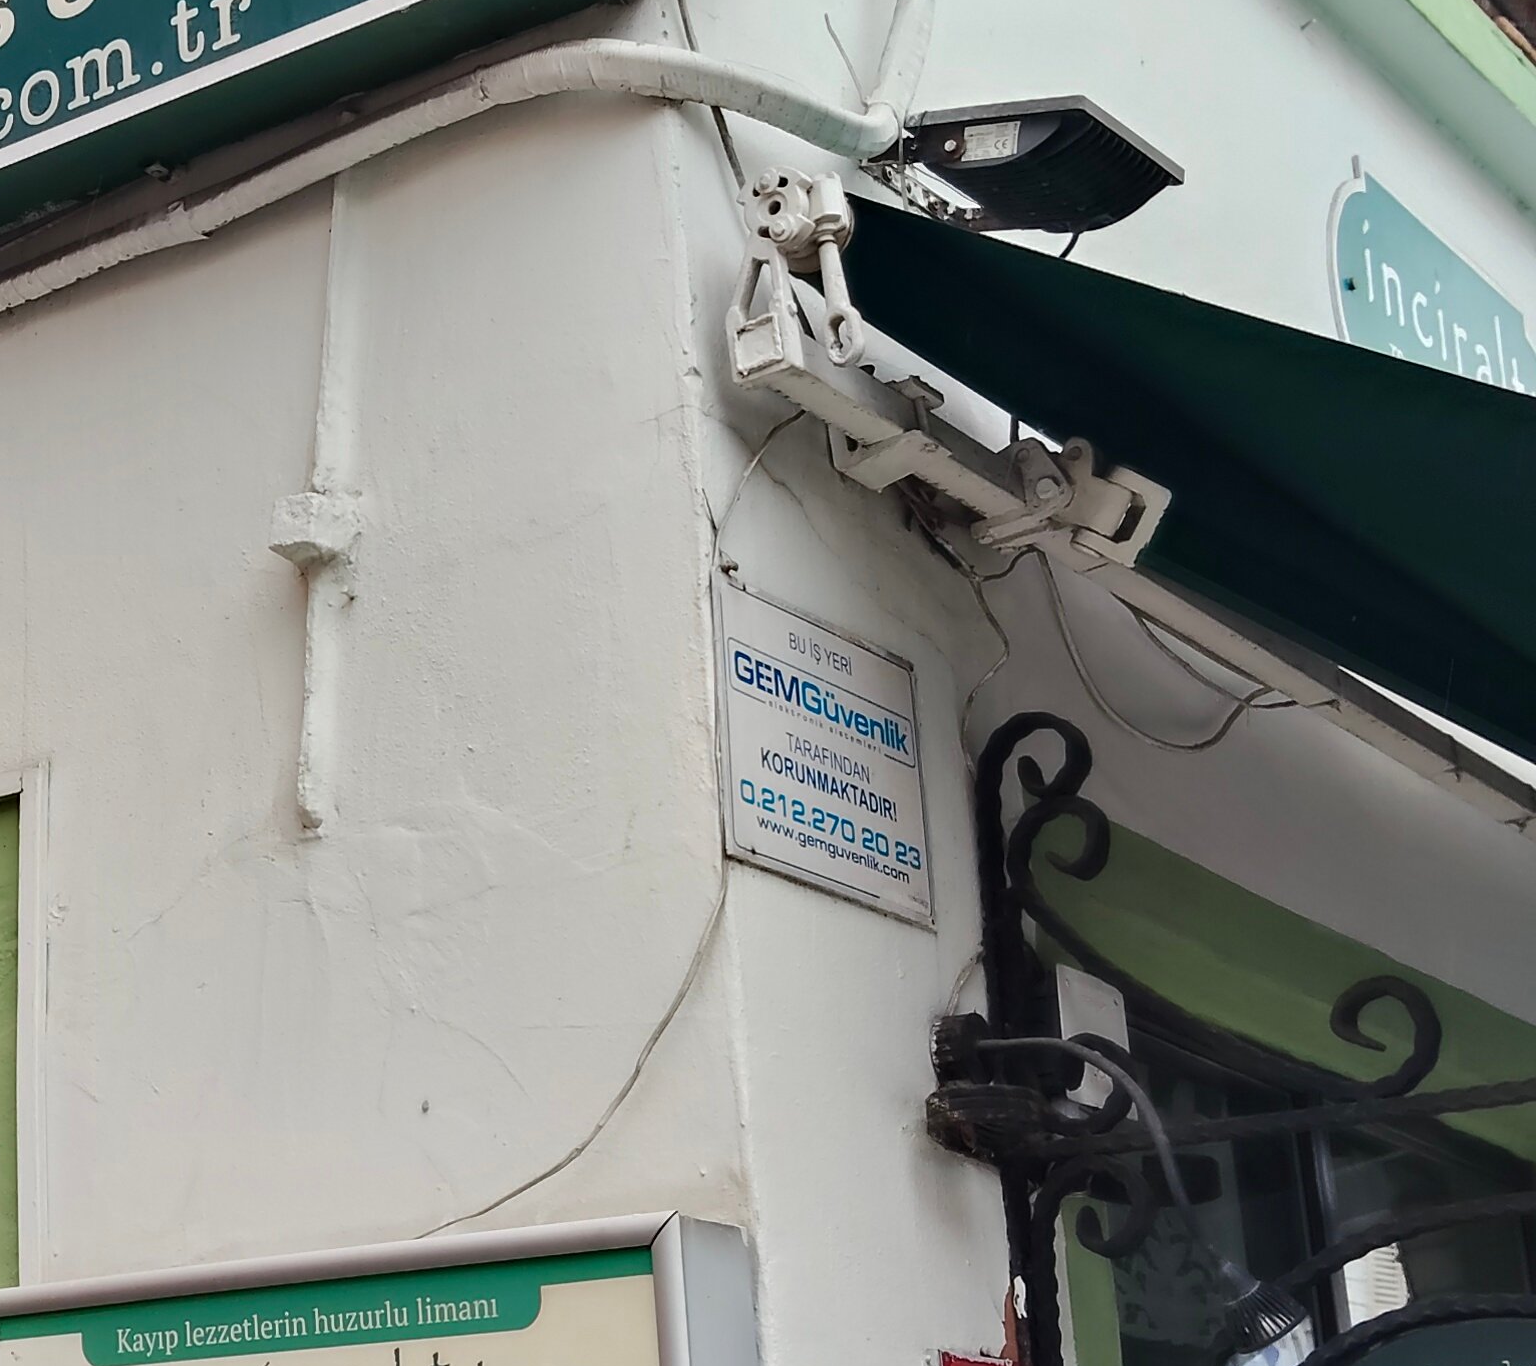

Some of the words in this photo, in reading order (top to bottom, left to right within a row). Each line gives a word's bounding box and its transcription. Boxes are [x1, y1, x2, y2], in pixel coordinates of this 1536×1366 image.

[788, 632, 806, 655] BU
[824, 649, 853, 677] YERİ
[734, 650, 909, 756] GEMGüvenlik
[761, 747, 898, 822] KORUNMAKTADIR!
[785, 731, 871, 784] TARAFINDAN
[740, 778, 856, 844] 0.212.270
[862, 828, 889, 857] 20
[895, 841, 921, 870] 23
[757, 815, 911, 884] www.gemguvenlik.com
[116, 1325, 178, 1357] Kayıp
[184, 1311, 307, 1348] lezzetlerin
[313, 1301, 409, 1335] huzurlu
[416, 1296, 499, 1325] limanı
